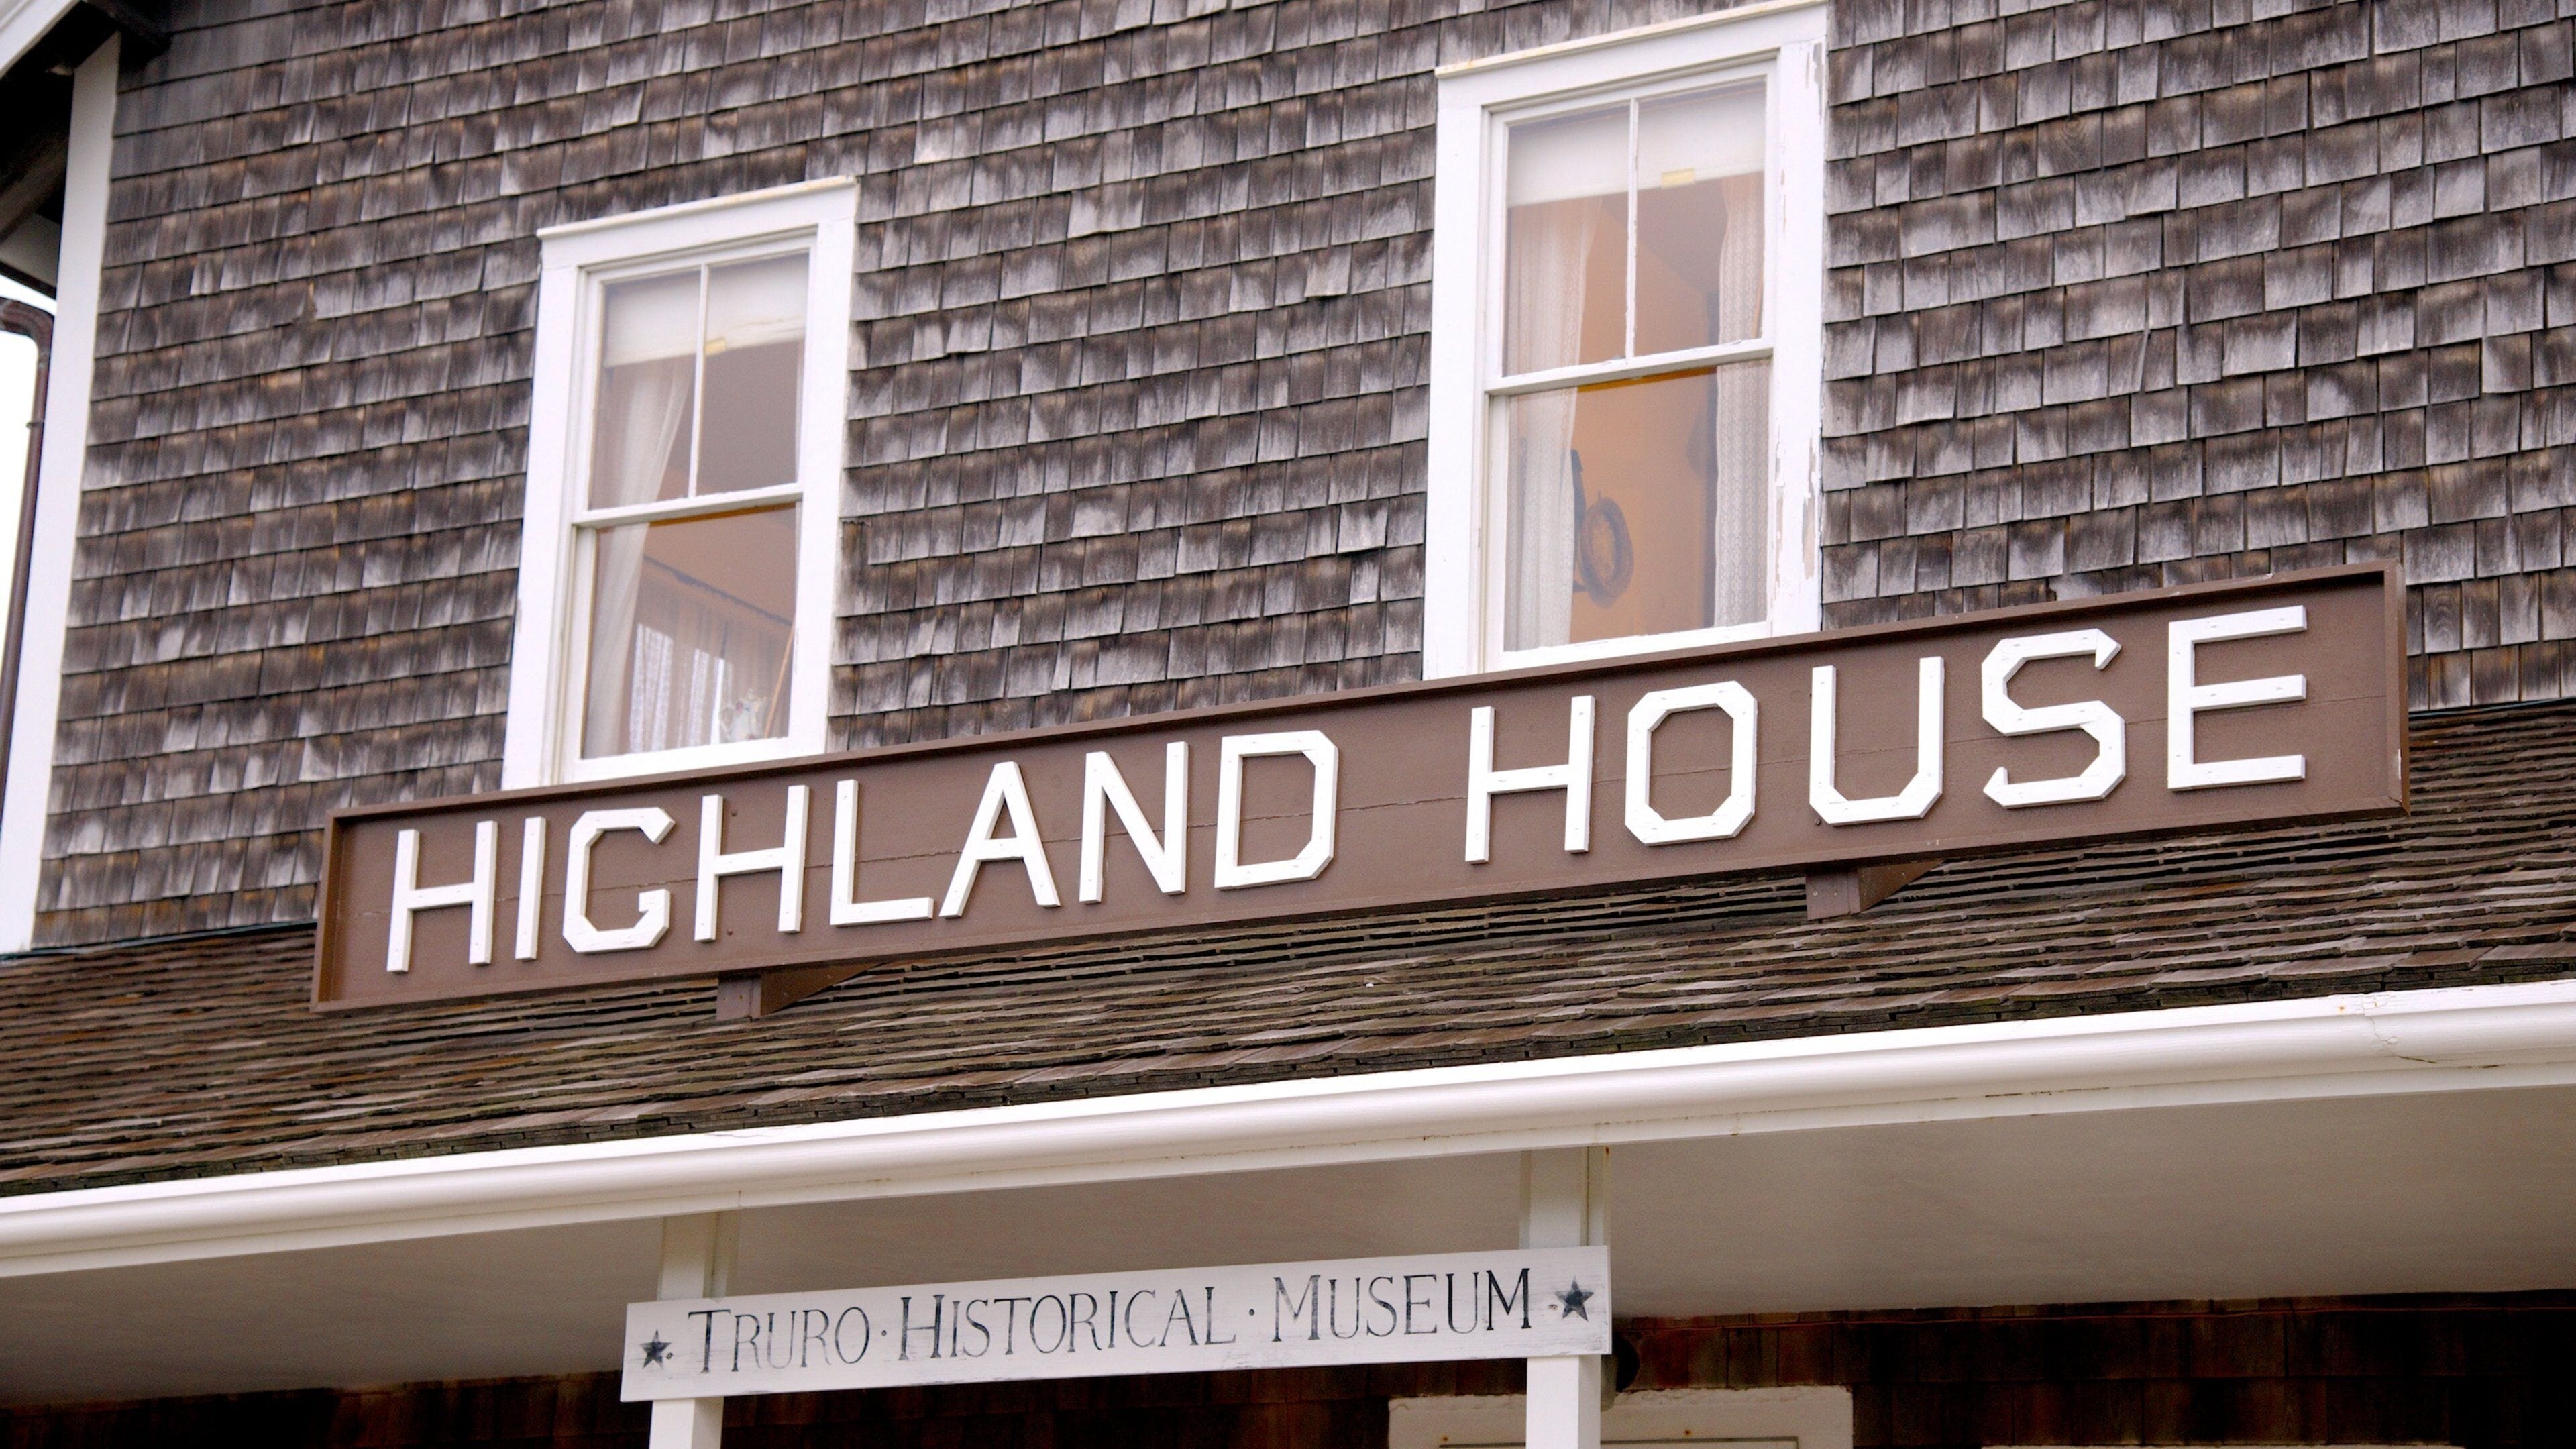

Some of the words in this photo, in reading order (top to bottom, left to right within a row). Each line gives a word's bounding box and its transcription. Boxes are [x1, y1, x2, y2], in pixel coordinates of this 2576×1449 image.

[386, 729, 1339, 973] HIGHLAND
[1465, 604, 2308, 864] HOUSE
[687, 1306, 871, 1373] TRURO
[898, 1286, 1236, 1361] HISTORICAL
[1271, 1267, 1532, 1342] MUSEUM
